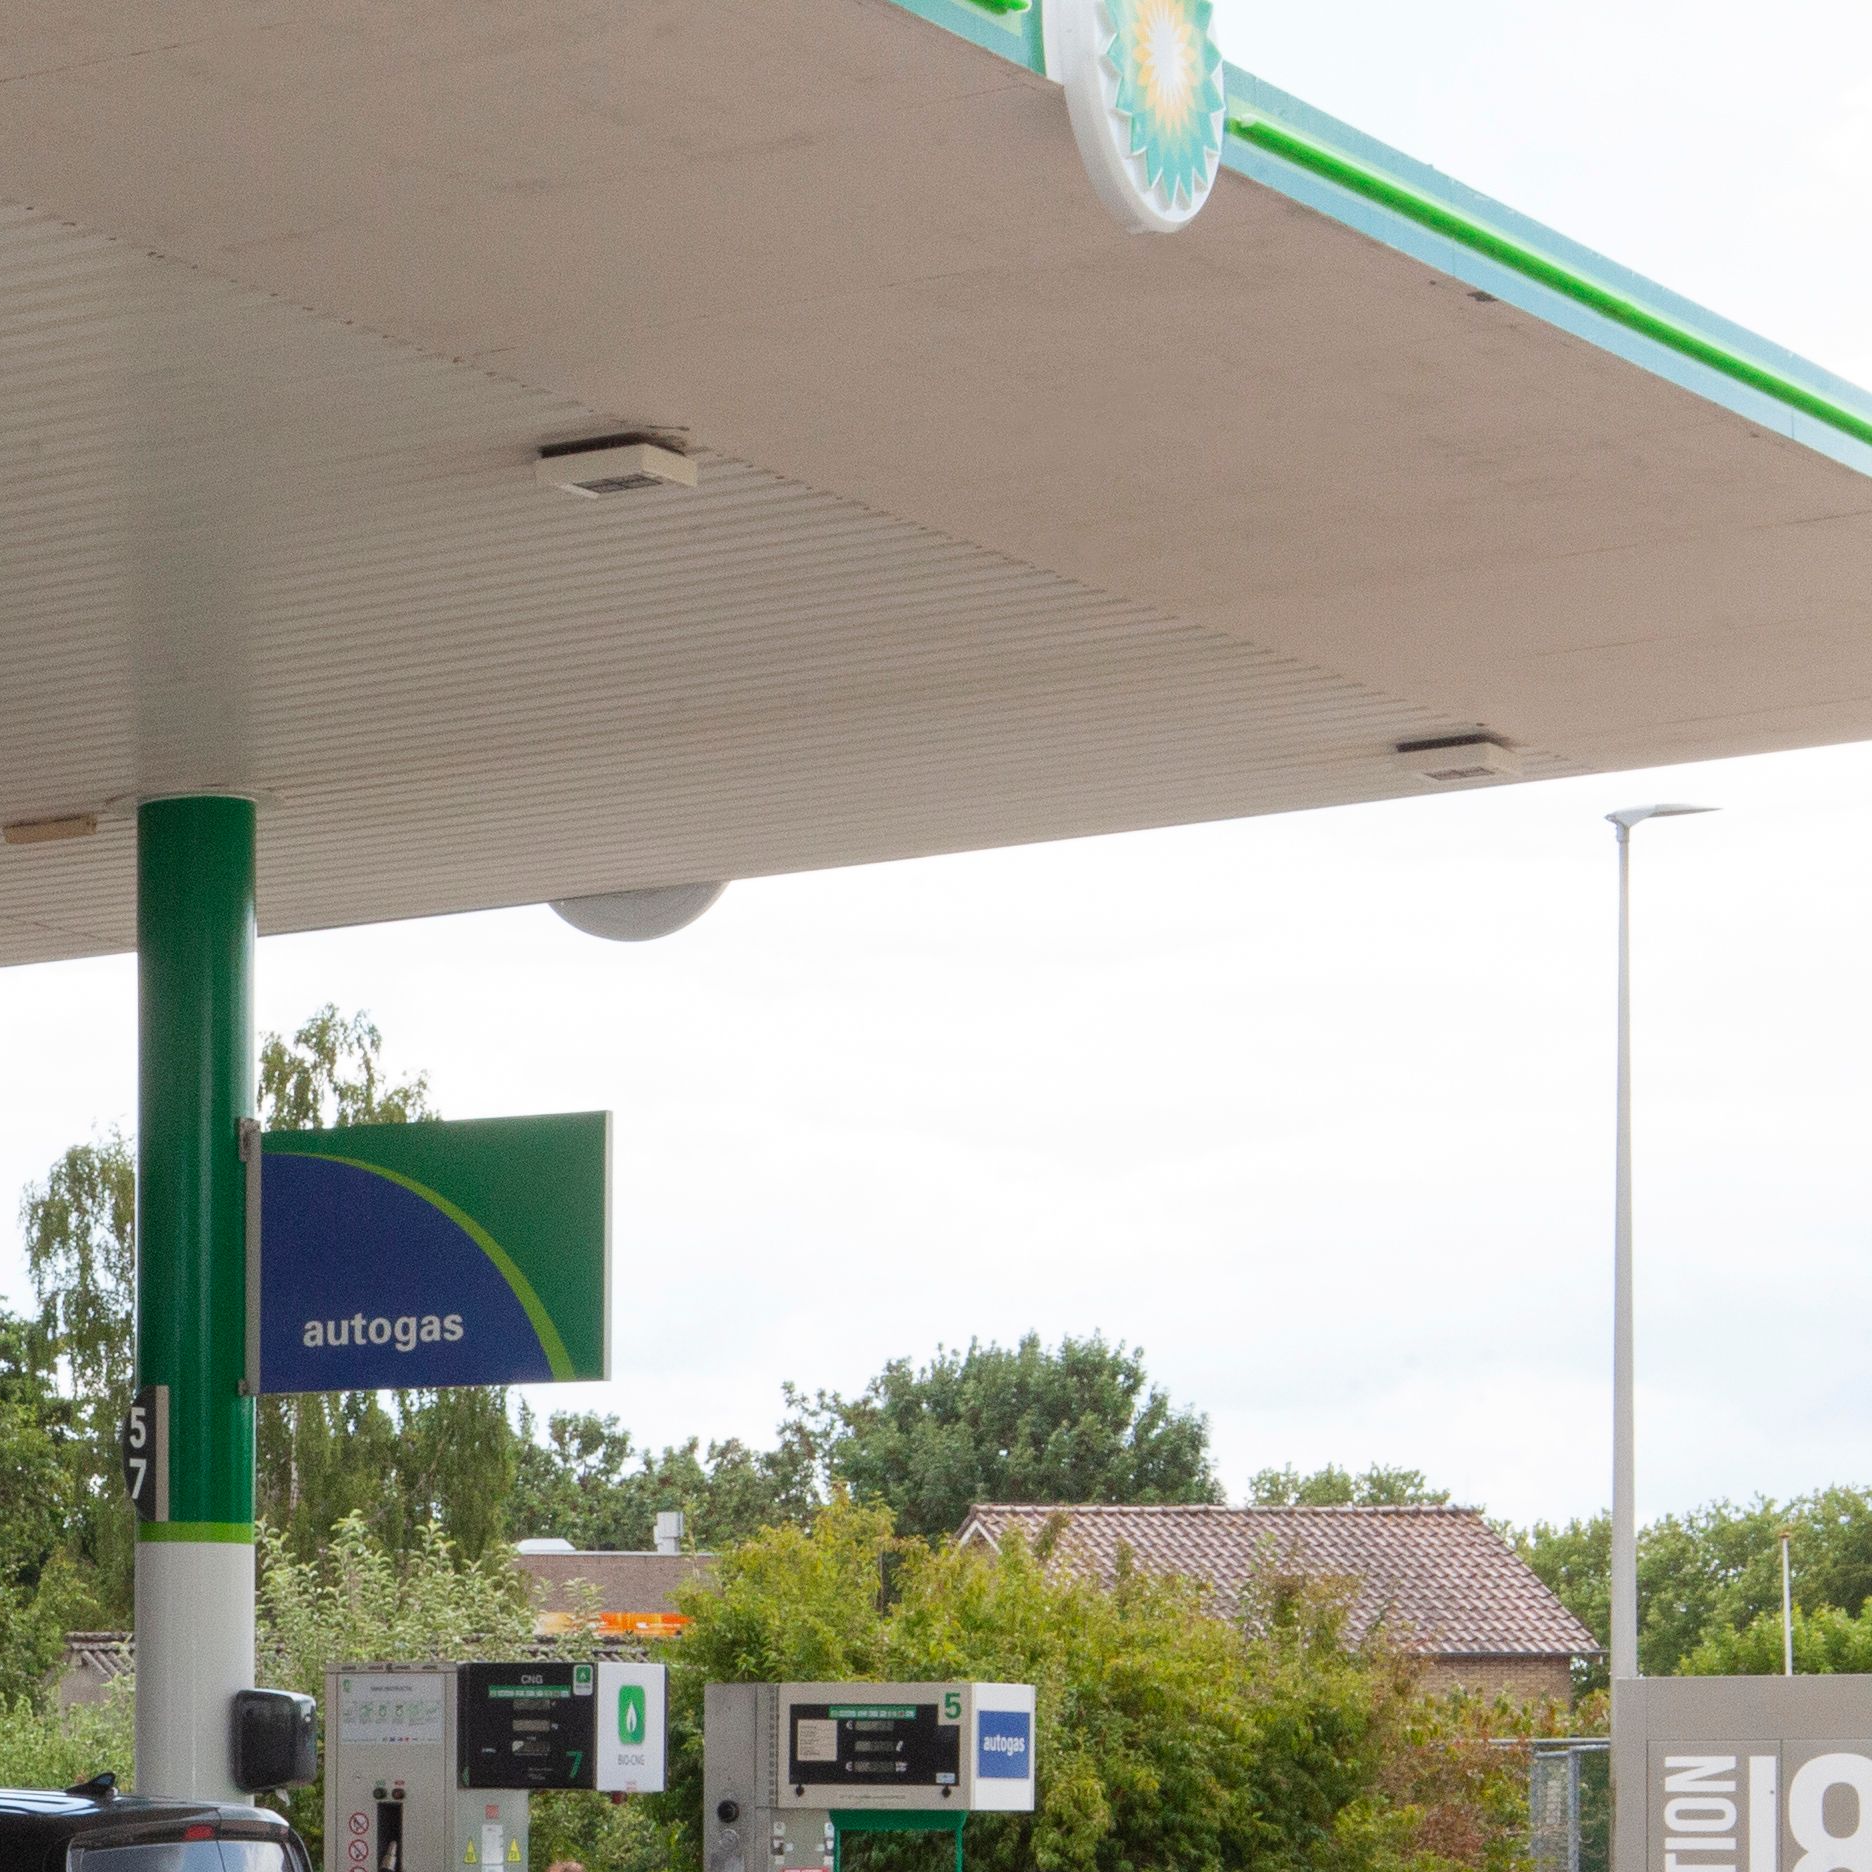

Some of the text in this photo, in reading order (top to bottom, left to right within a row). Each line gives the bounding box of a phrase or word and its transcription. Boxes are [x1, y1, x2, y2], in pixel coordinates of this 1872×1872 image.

[302, 1312, 465, 1352] autogas
[129, 1406, 147, 1449] 5
[129, 1457, 147, 1500] 7
[944, 1692, 962, 1720] 5
[983, 1731, 1026, 1757] autogas
[566, 1750, 583, 1779] 7
[617, 1753, 645, 1766] BIO-CNG
